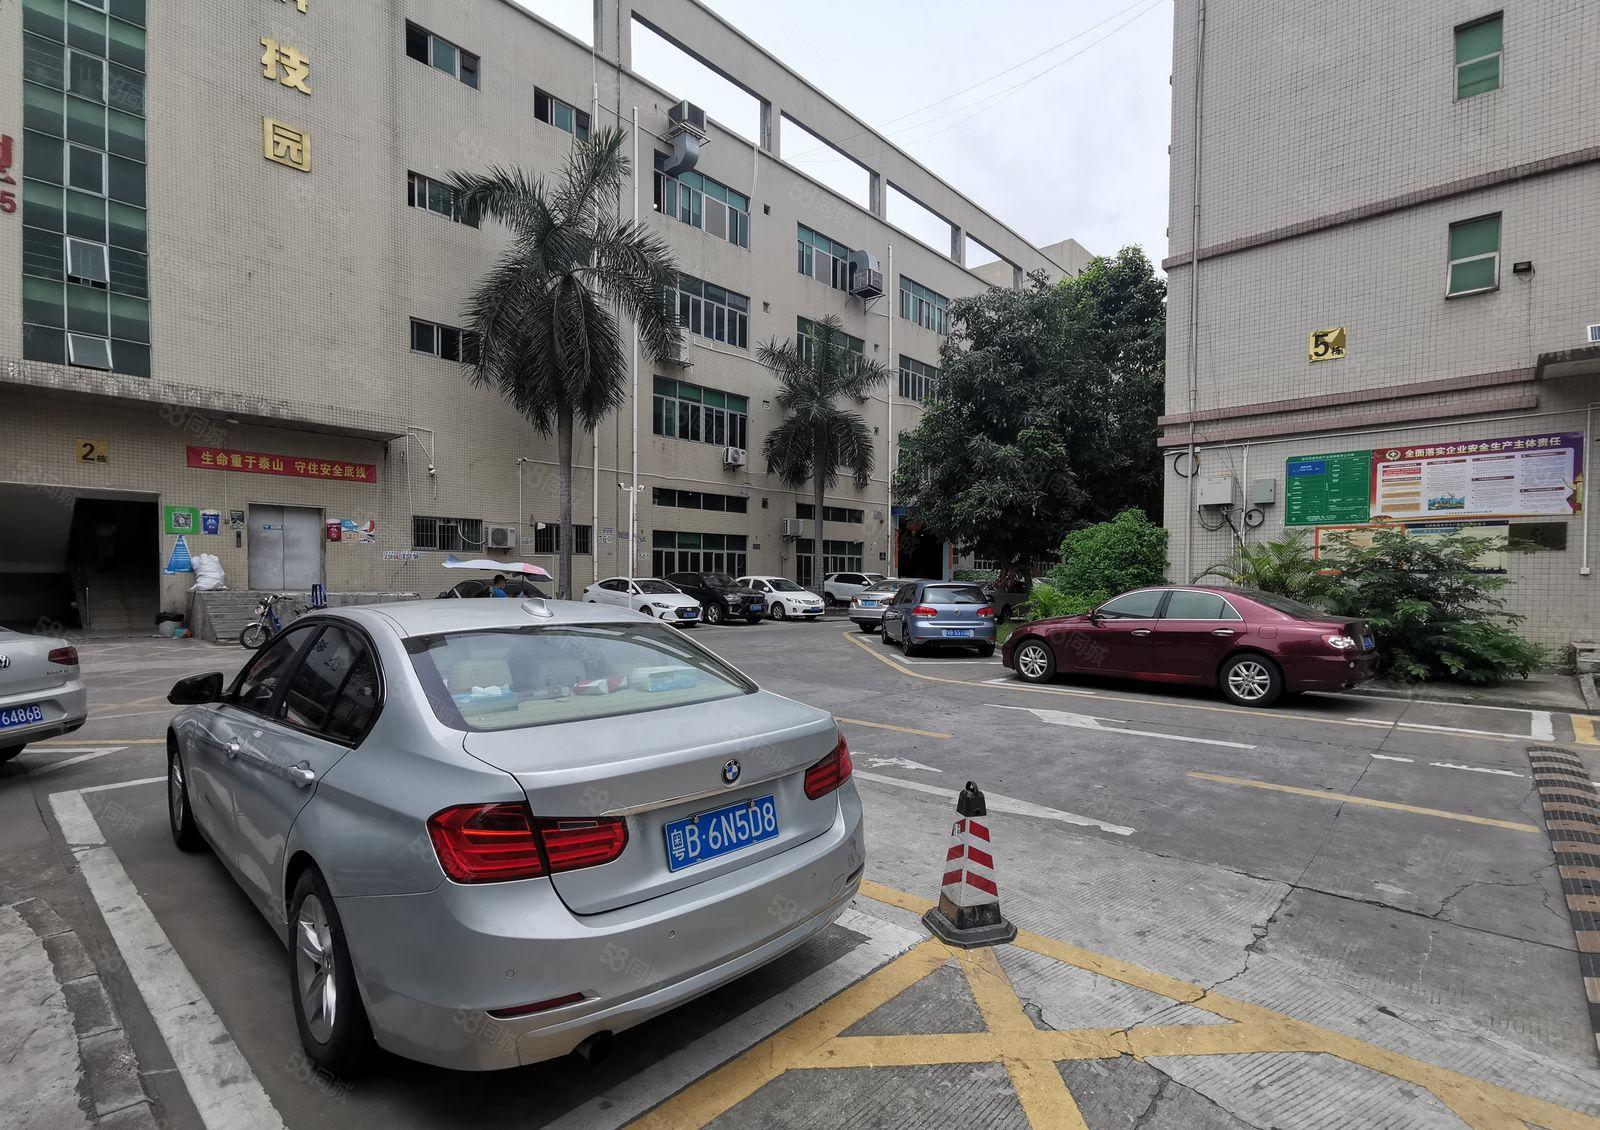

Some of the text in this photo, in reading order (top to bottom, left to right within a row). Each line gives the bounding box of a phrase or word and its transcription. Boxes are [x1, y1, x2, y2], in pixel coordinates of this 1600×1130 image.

[260, 0, 312, 173] 技园
[1404, 437, 1562, 459] 全面落实企业安全生产主体责任
[201, 451, 367, 480] 生命重于泰山 守住安全底线
[1, 706, 42, 725] 6486B
[671, 802, 776, 861] 粤B·6N5D8
